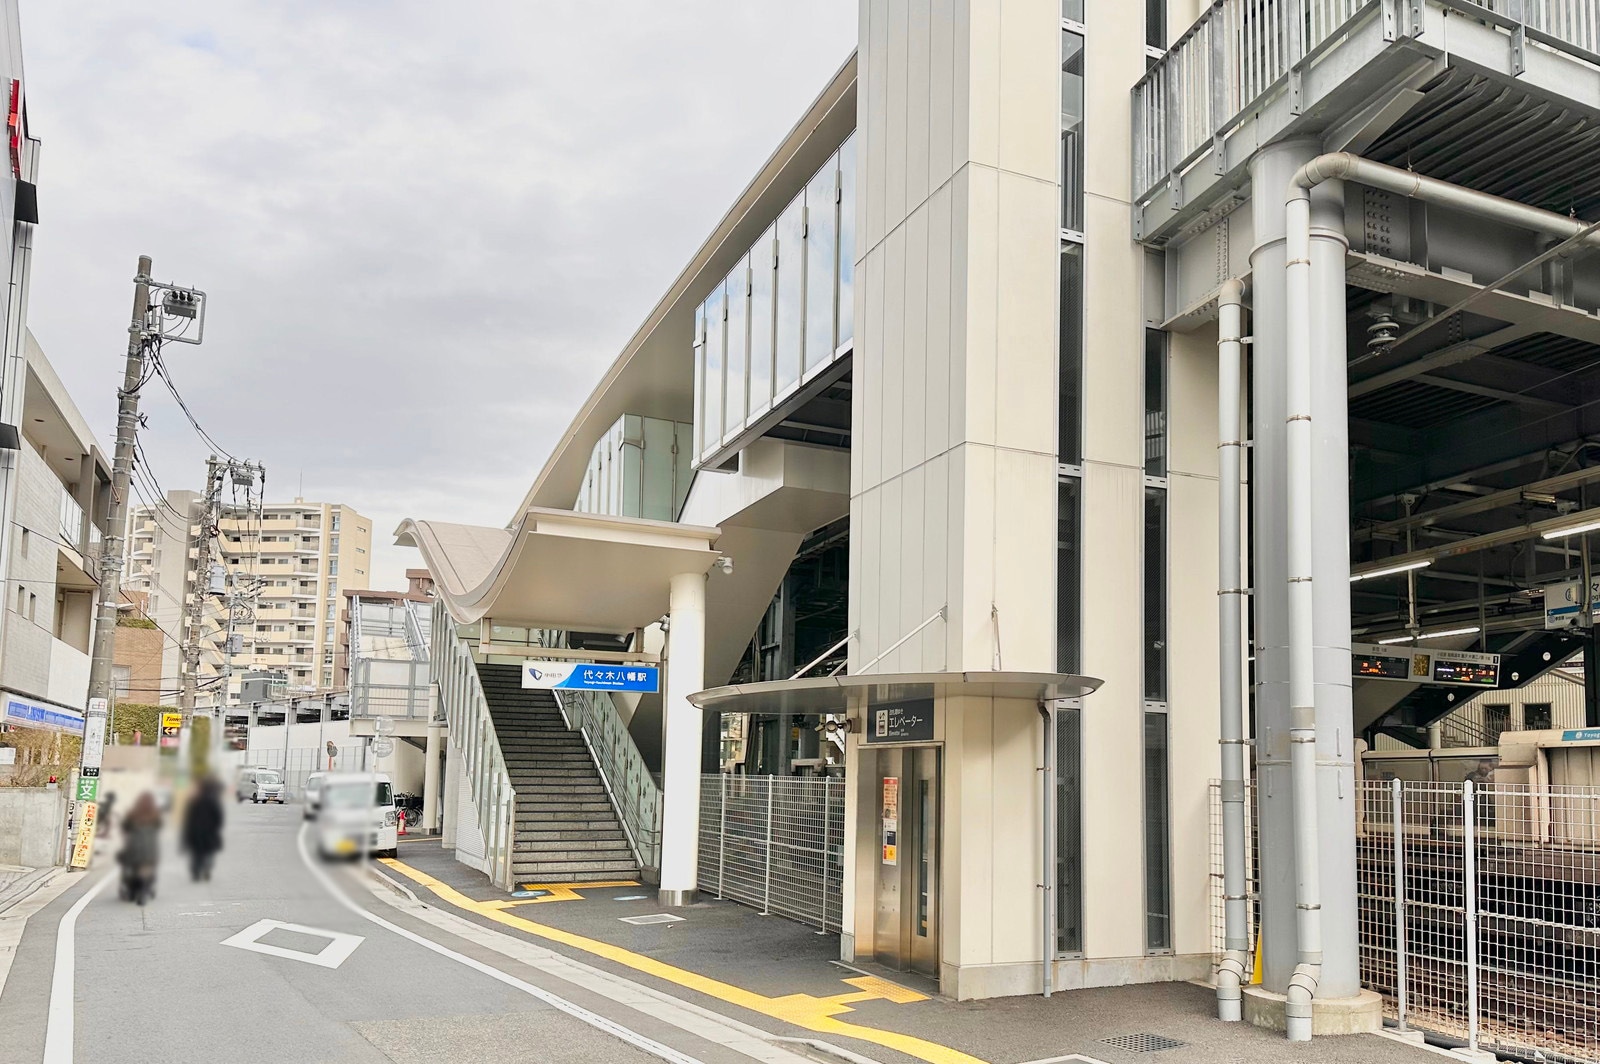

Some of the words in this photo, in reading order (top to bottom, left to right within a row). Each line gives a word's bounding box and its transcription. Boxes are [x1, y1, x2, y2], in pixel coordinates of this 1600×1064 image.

[583, 669, 647, 682] 代々木八幡駅
[889, 715, 923, 728] エレベーター
